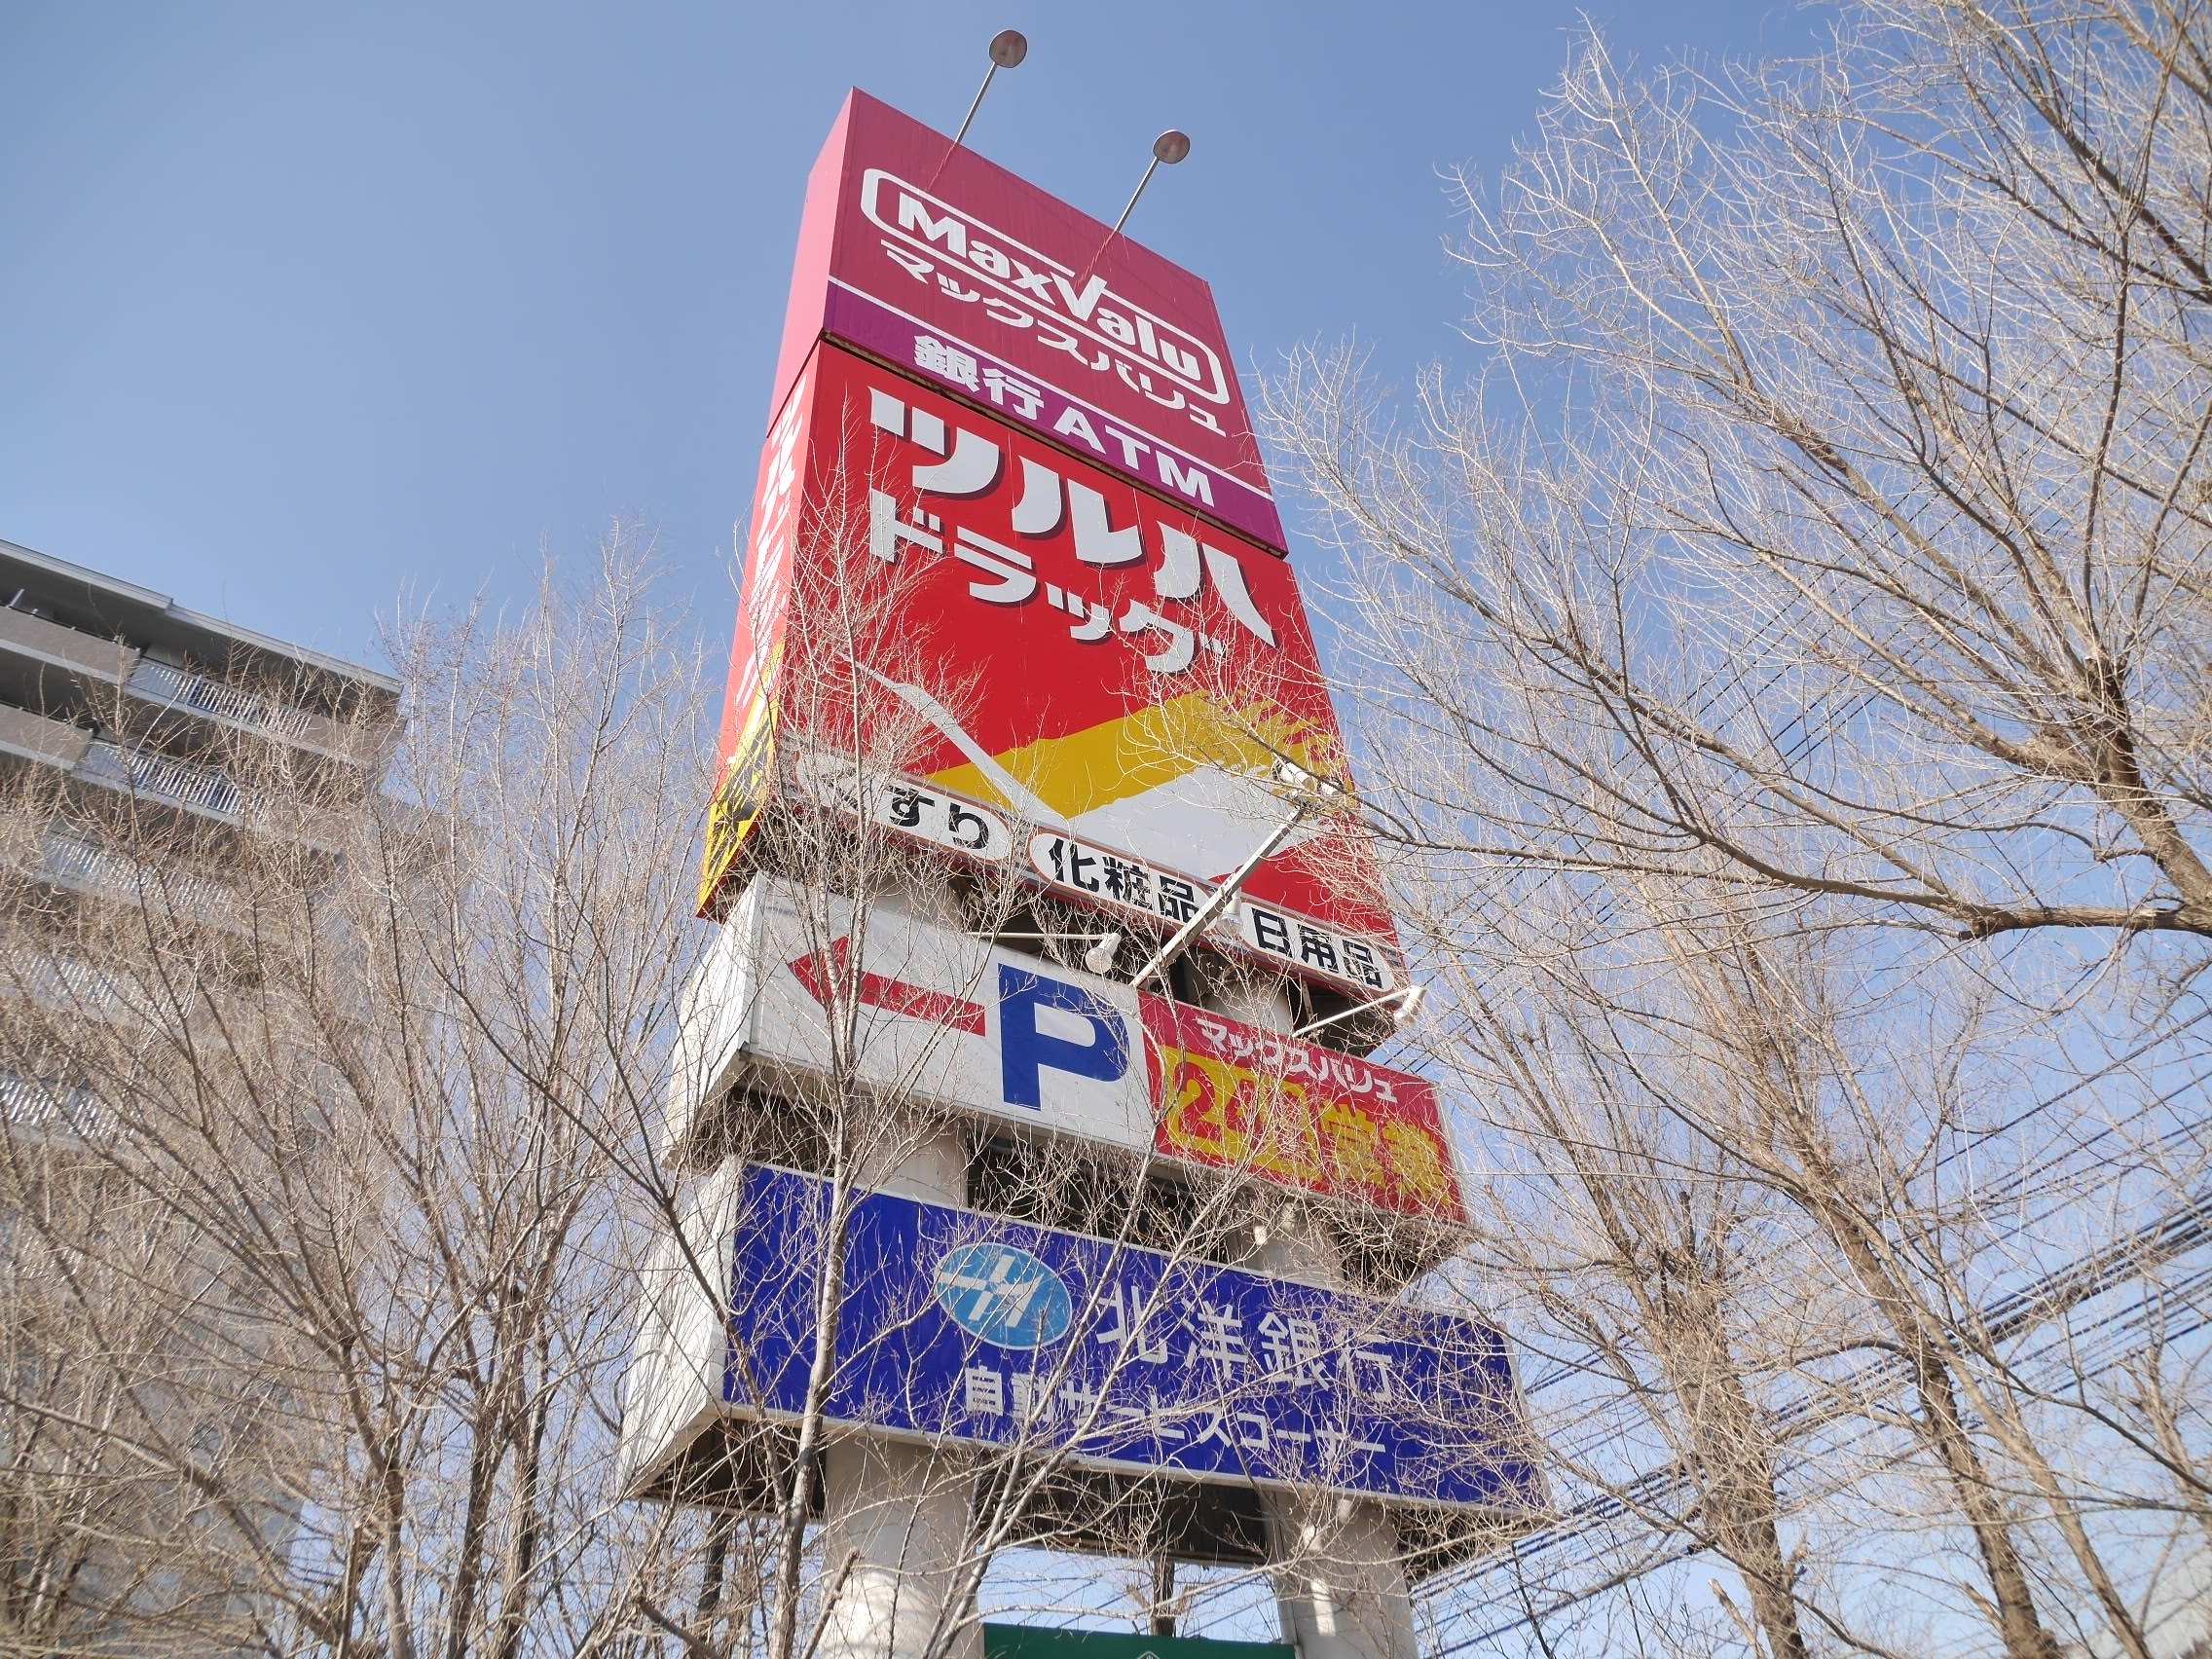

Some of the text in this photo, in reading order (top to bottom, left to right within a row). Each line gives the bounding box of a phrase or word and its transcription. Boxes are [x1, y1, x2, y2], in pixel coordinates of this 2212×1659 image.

[885, 244, 1227, 438] マックスバリュ
[898, 191, 1202, 385] MaxValu
[913, 334, 1216, 508] 銀行 ATM
[867, 386, 1277, 648] ツルハ
[869, 488, 1226, 675] ドラッグ
[1047, 837, 1200, 924] 化粧品
[1251, 907, 1383, 989] 日用品
[997, 962, 1130, 1111] P
[1197, 1017, 1398, 1104] マックスバリュ
[1096, 1283, 1393, 1404] 北洋銀行
